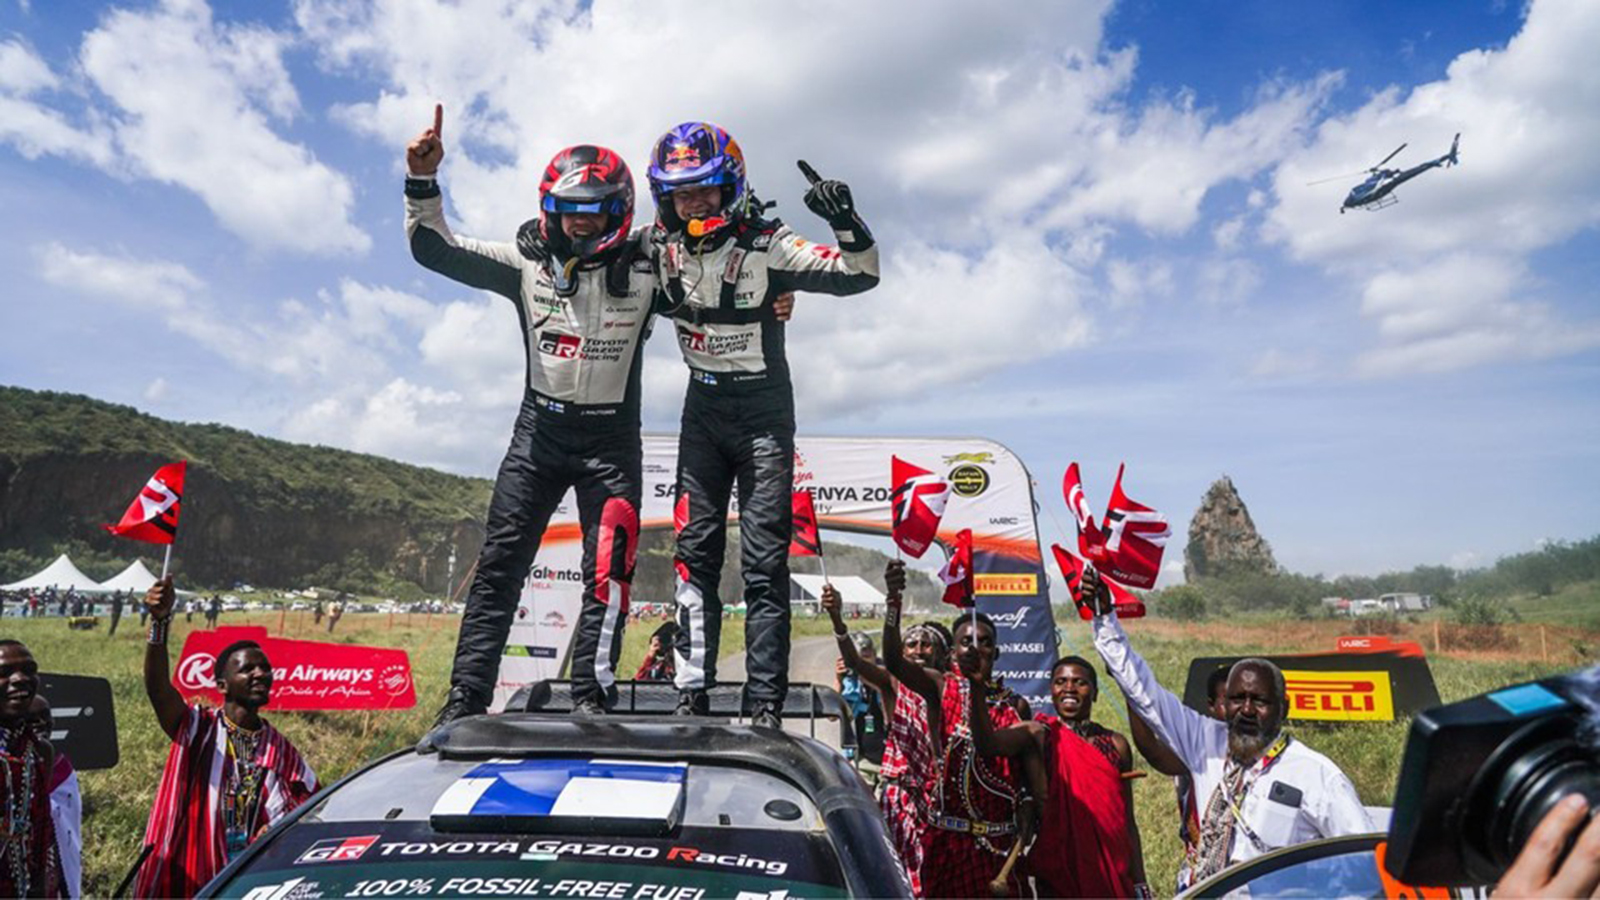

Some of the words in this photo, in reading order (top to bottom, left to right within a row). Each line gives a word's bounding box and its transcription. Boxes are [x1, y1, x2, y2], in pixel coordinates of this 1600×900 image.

[551, 163, 608, 193] GR
[587, 338, 629, 346] TOYOTA
[707, 332, 754, 343] TOYOTA
[538, 340, 577, 358] GR
[582, 346, 624, 354] GAZOO
[989, 517, 1018, 525] WRC
[1340, 639, 1371, 647] WRC
[289, 664, 373, 684] Airways
[991, 670, 1051, 679] FANATEC
[1286, 694, 1375, 711] ELLI
[302, 846, 365, 860] GR
[380, 841, 519, 855] TOYOTA
[528, 841, 660, 859] GAZOO
[666, 846, 788, 875] Racing
[345, 878, 436, 897] 100%
[438, 878, 633, 898] FOSSIL-FREE
[633, 884, 706, 900] FUEL
